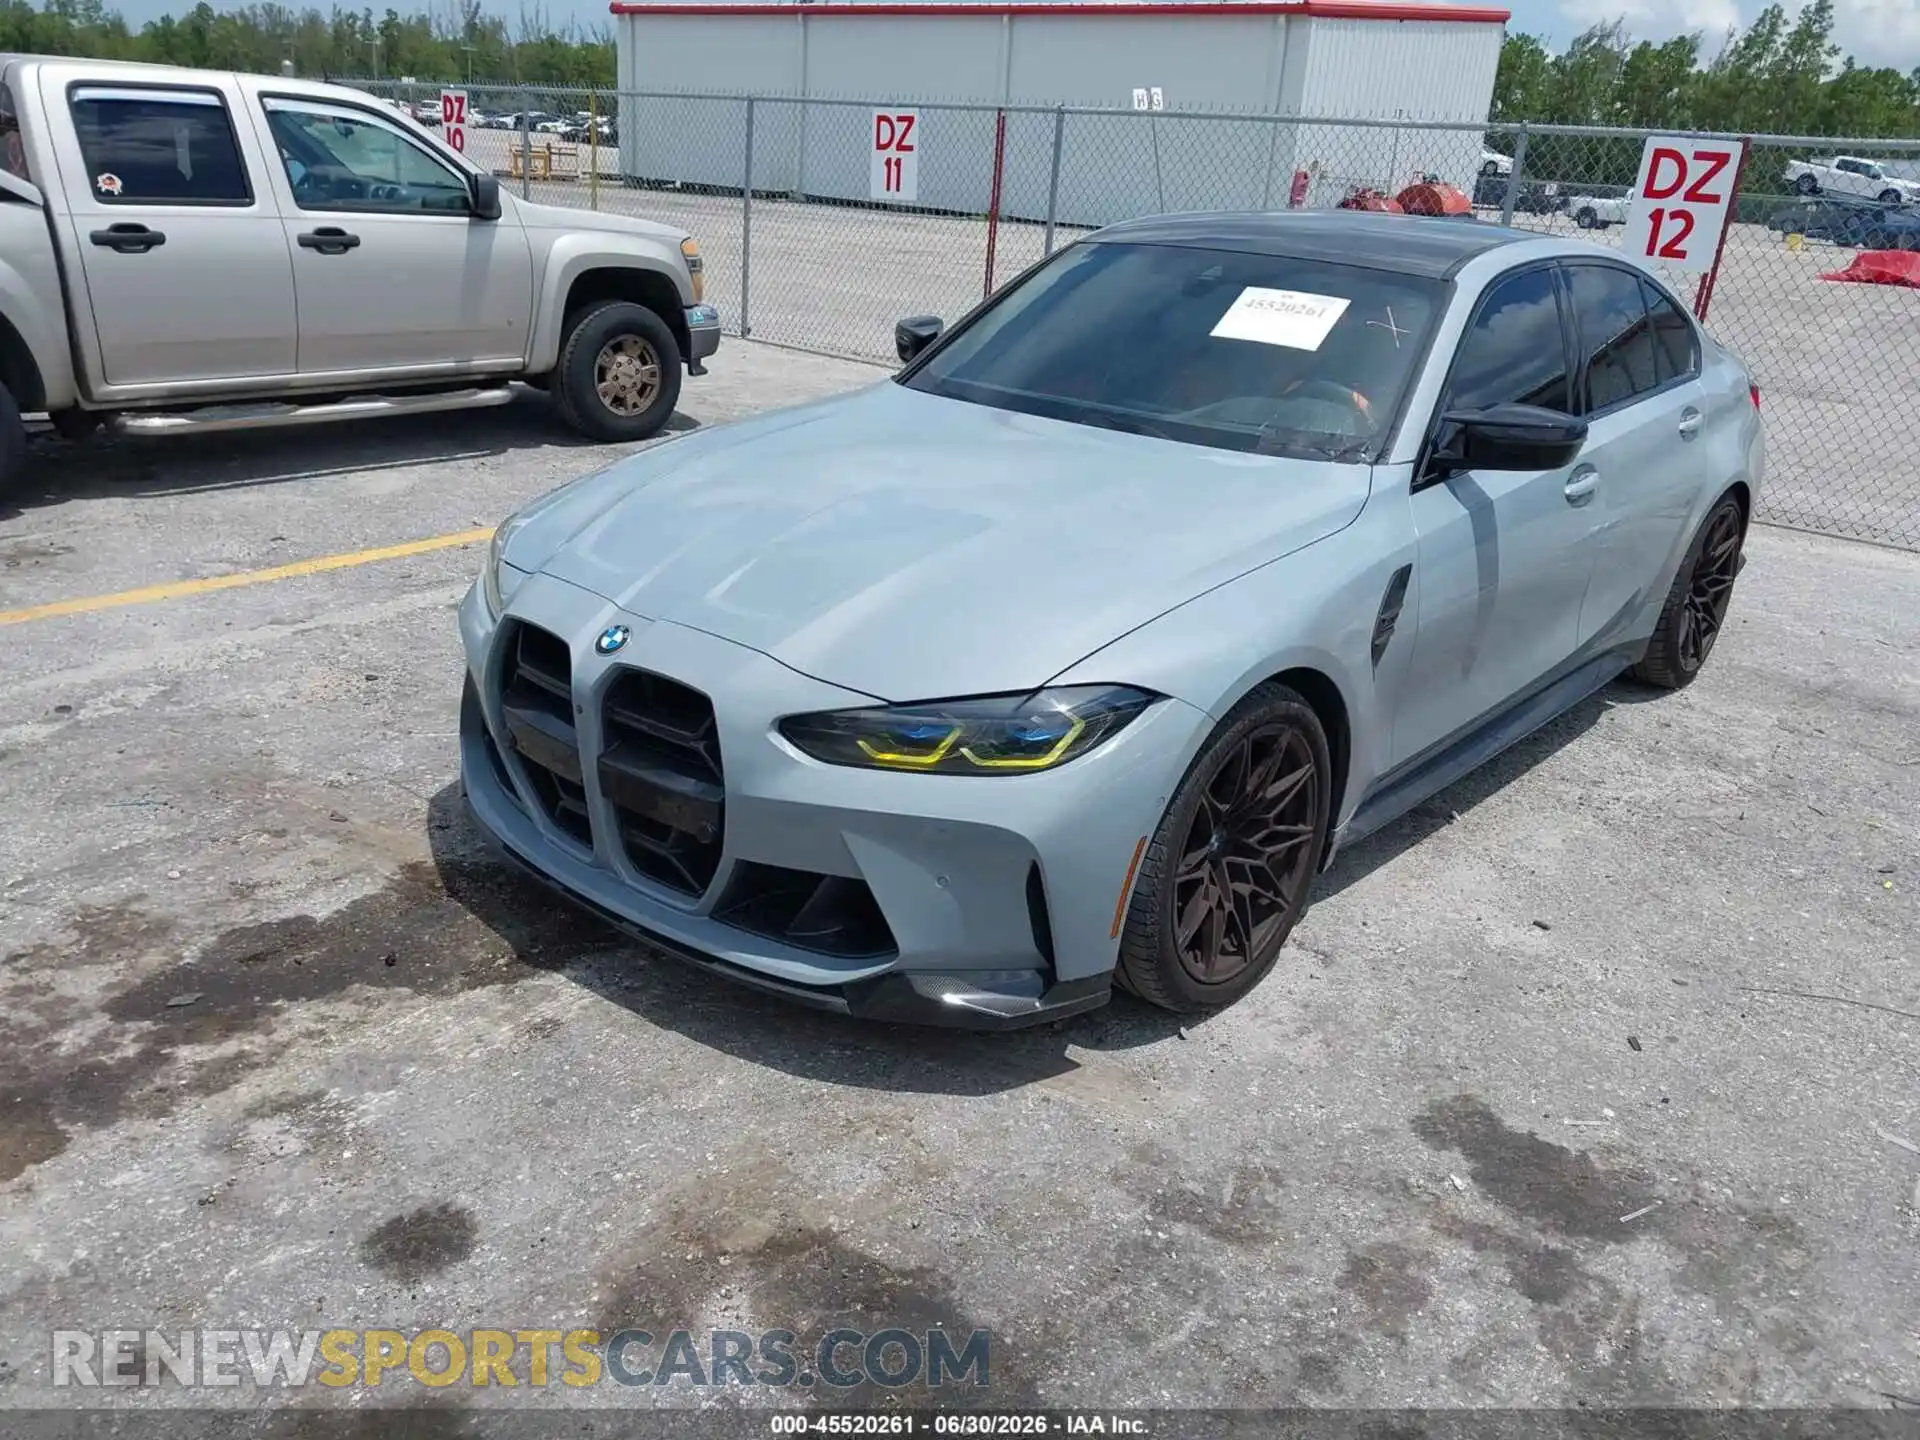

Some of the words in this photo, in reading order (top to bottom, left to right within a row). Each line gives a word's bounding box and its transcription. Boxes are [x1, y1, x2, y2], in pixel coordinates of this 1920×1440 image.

[443, 95, 465, 124] DZ
[446, 126, 465, 153] 10
[876, 115, 915, 151] DZ
[884, 157, 901, 192] 11
[1643, 148, 1731, 204] DZ
[1646, 208, 1695, 259] 12
[1244, 299, 1328, 318] 45520261
